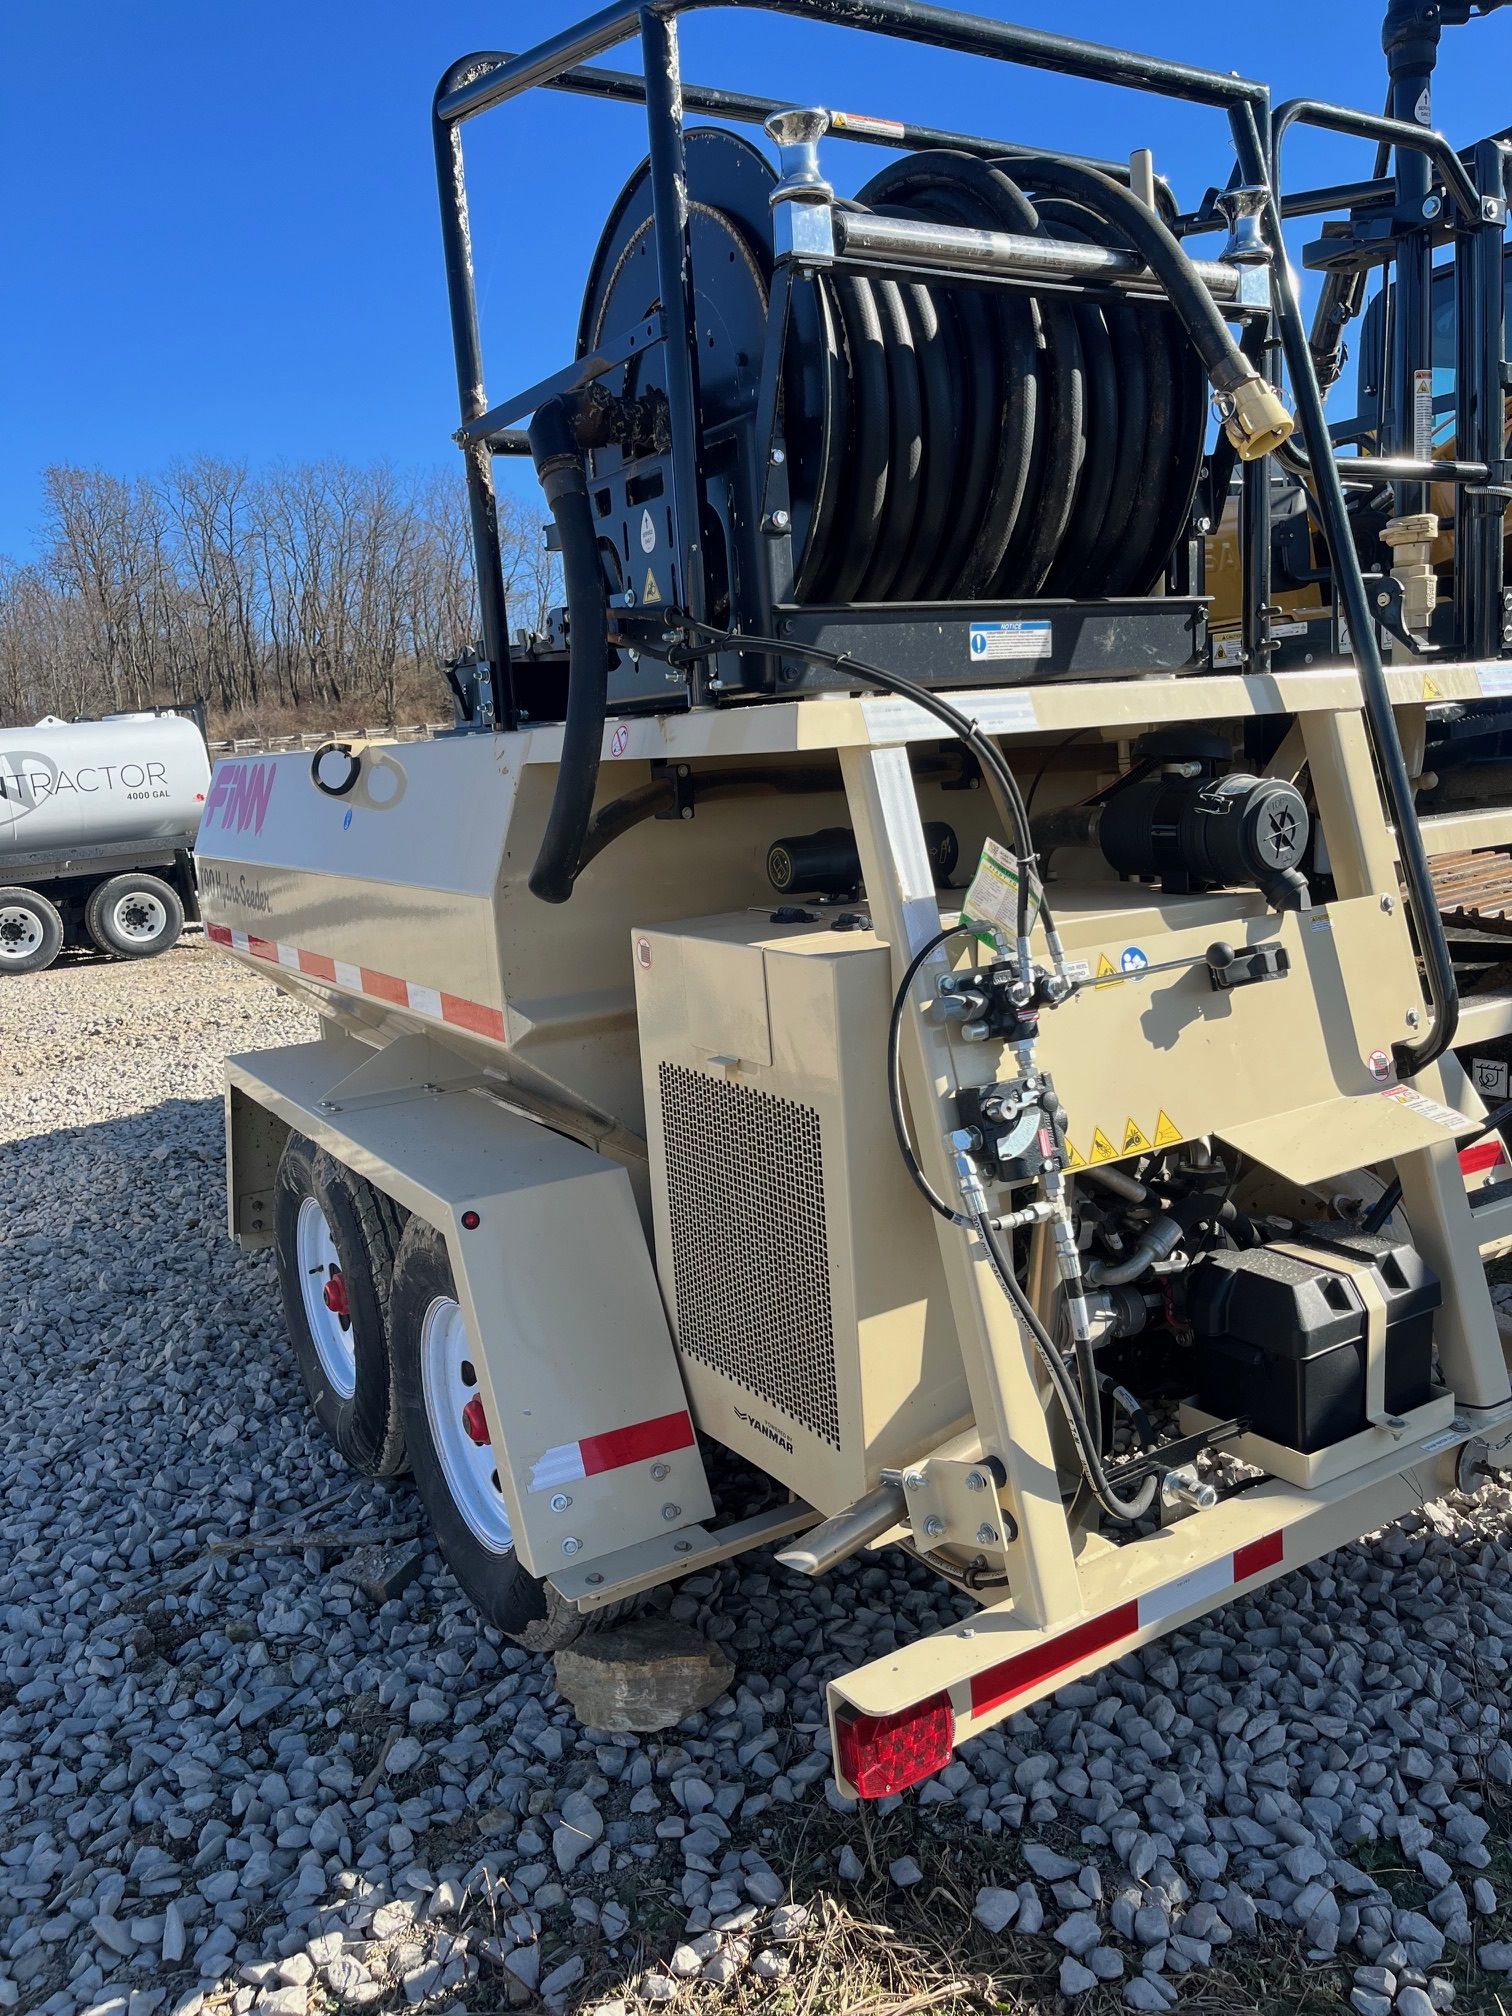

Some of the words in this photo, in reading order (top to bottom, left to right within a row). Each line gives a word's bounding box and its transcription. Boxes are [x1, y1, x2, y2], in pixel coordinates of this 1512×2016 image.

[127, 791, 150, 800] 4000
[152, 790, 171, 799] GAL
[205, 762, 277, 837] FINN
[748, 1415, 793, 1454] YANMAR
